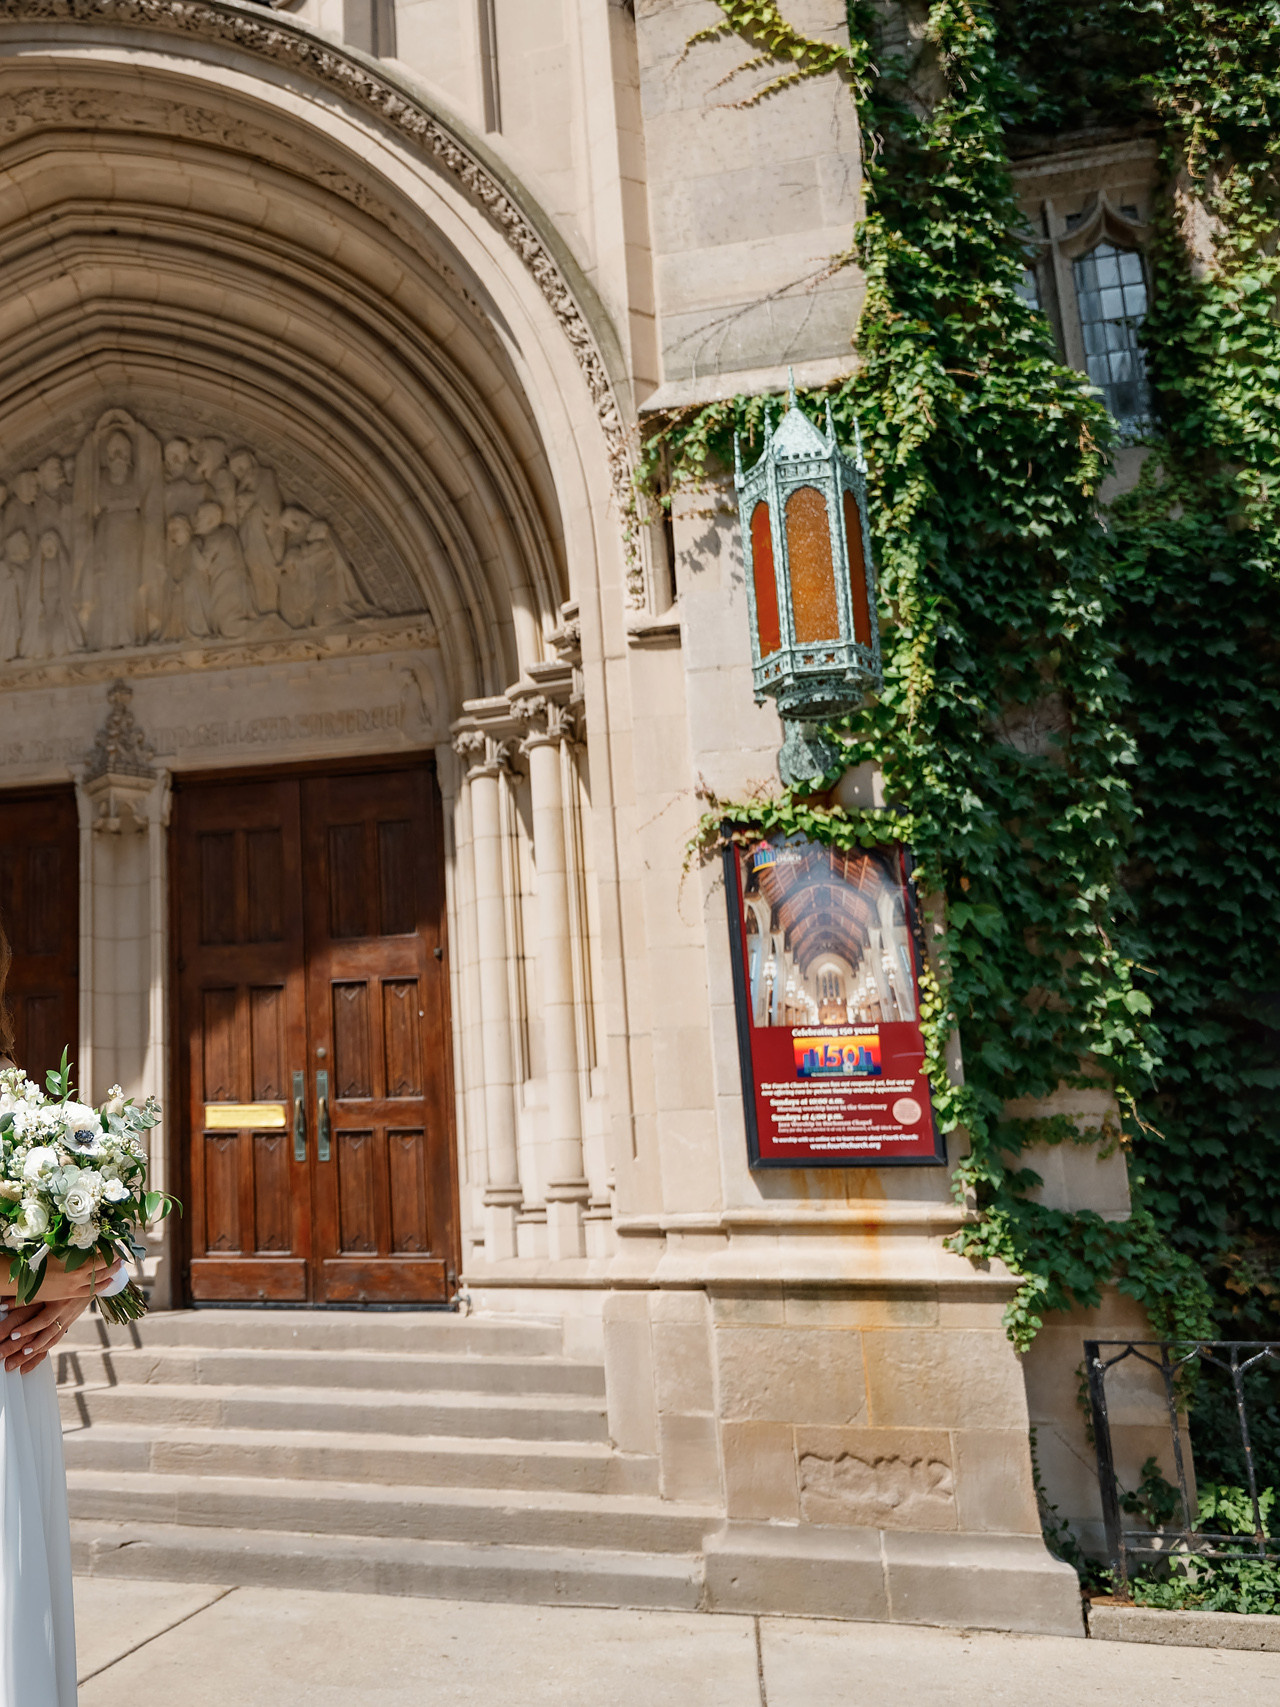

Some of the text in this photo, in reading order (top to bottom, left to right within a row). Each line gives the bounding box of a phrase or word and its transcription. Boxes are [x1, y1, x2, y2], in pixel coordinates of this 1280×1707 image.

[792, 1024, 879, 1037] Celebrating 150 years!
[815, 1045, 860, 1067] 150
[770, 1098, 800, 1107] Sundays
[771, 1113, 801, 1122] Sundays
[802, 1113, 809, 1121] at
